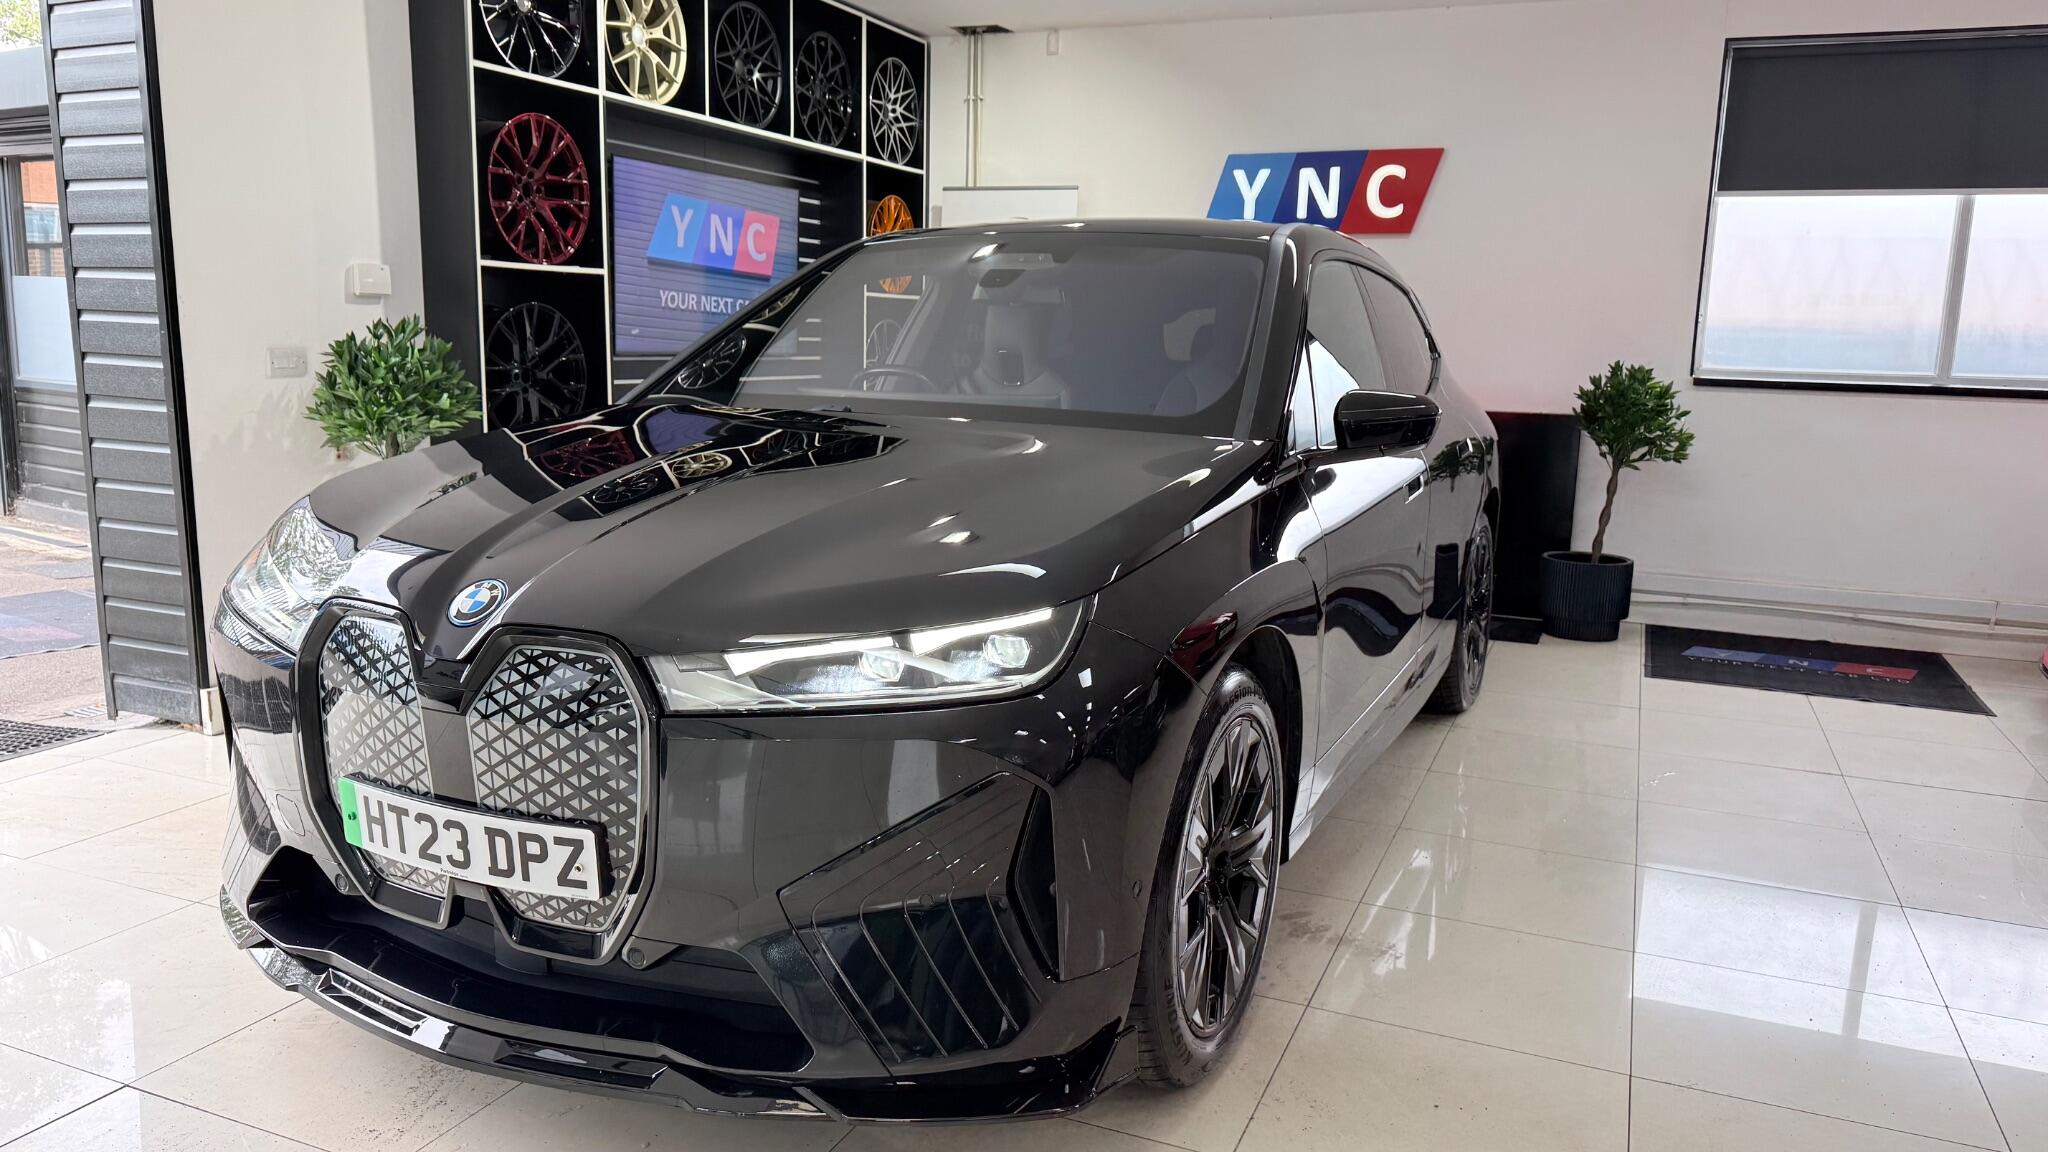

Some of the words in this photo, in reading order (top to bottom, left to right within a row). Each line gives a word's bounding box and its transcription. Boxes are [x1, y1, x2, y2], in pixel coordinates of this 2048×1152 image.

[1233, 164, 1407, 220] YNC
[671, 204, 767, 262] YNC
[659, 289, 697, 310] YOUR
[701, 295, 733, 313] NEXT
[363, 795, 472, 871] HT23
[484, 826, 588, 890] DPZ
